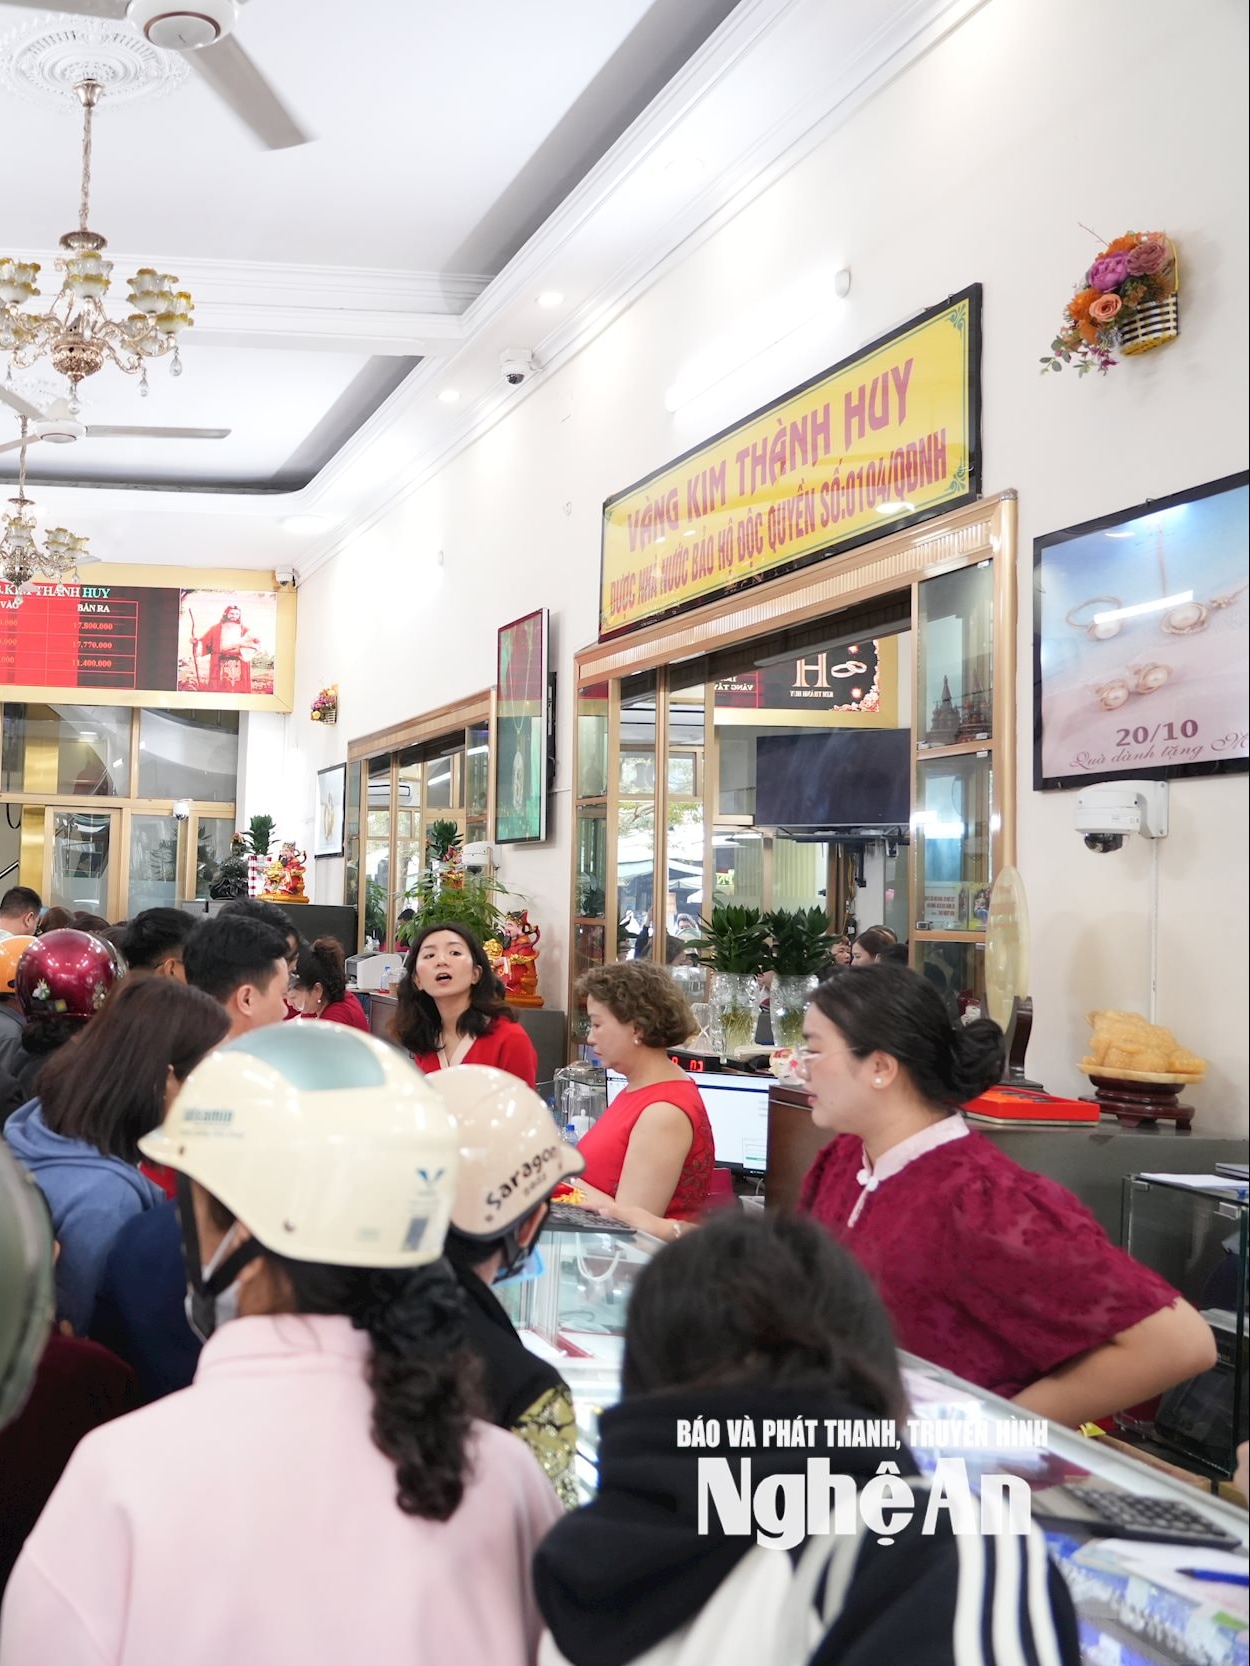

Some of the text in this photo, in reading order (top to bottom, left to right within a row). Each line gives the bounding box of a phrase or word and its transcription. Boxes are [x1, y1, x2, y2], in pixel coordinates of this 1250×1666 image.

[627, 357, 914, 552] VÀNG KIM THÀNH HUY
[691, 526, 714, 581] BẢO
[718, 518, 734, 576] HỘ
[737, 506, 763, 568] ĐỘC
[768, 478, 815, 554] QUYỀN
[82, 587, 110, 599] HUY
[97, 604, 110, 613] RA
[72, 641, 112, 649] 17.770.000
[1116, 719, 1199, 747] 20/10
[1069, 751, 1106, 770] Quà
[1111, 745, 1154, 766] dành
[1160, 743, 1204, 761] tặng
